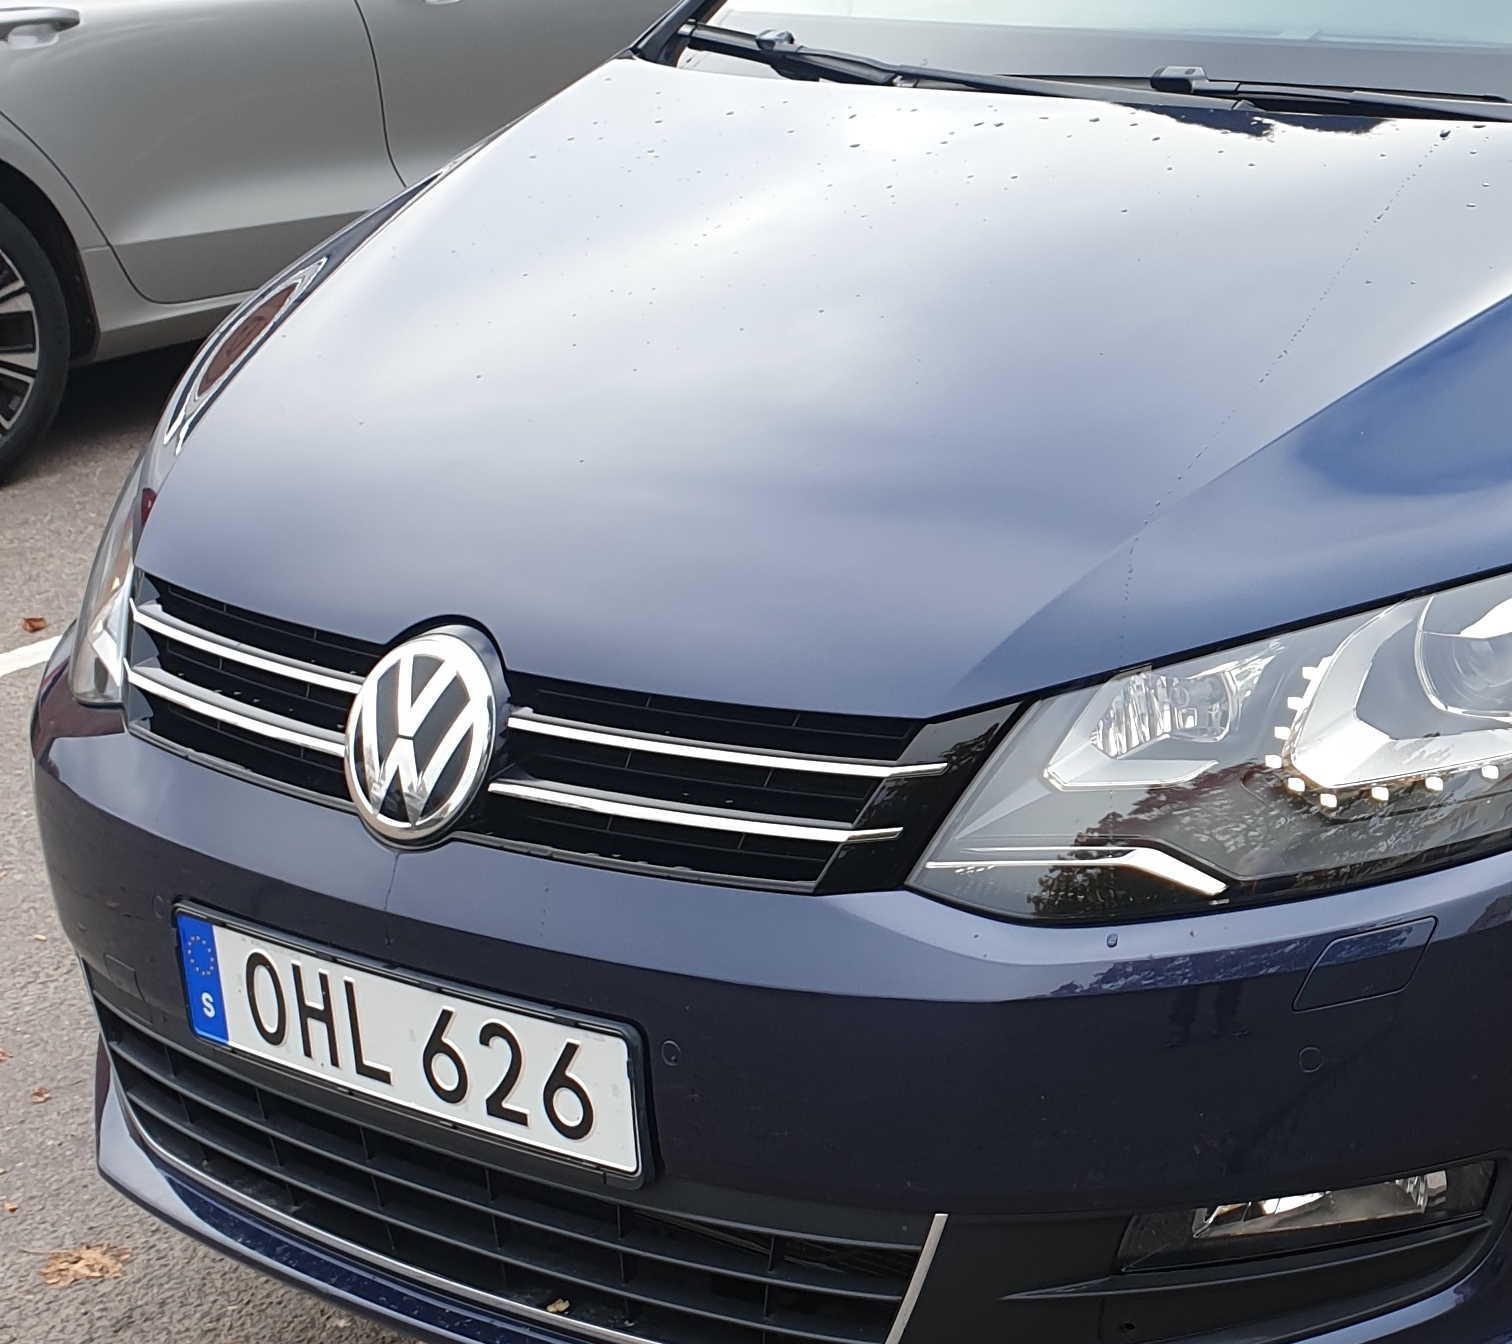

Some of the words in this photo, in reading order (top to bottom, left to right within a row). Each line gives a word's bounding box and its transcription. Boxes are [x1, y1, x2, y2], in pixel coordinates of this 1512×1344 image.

[202, 991, 216, 1019] S
[245, 950, 393, 1086] OHL
[422, 1007, 595, 1141] 626
